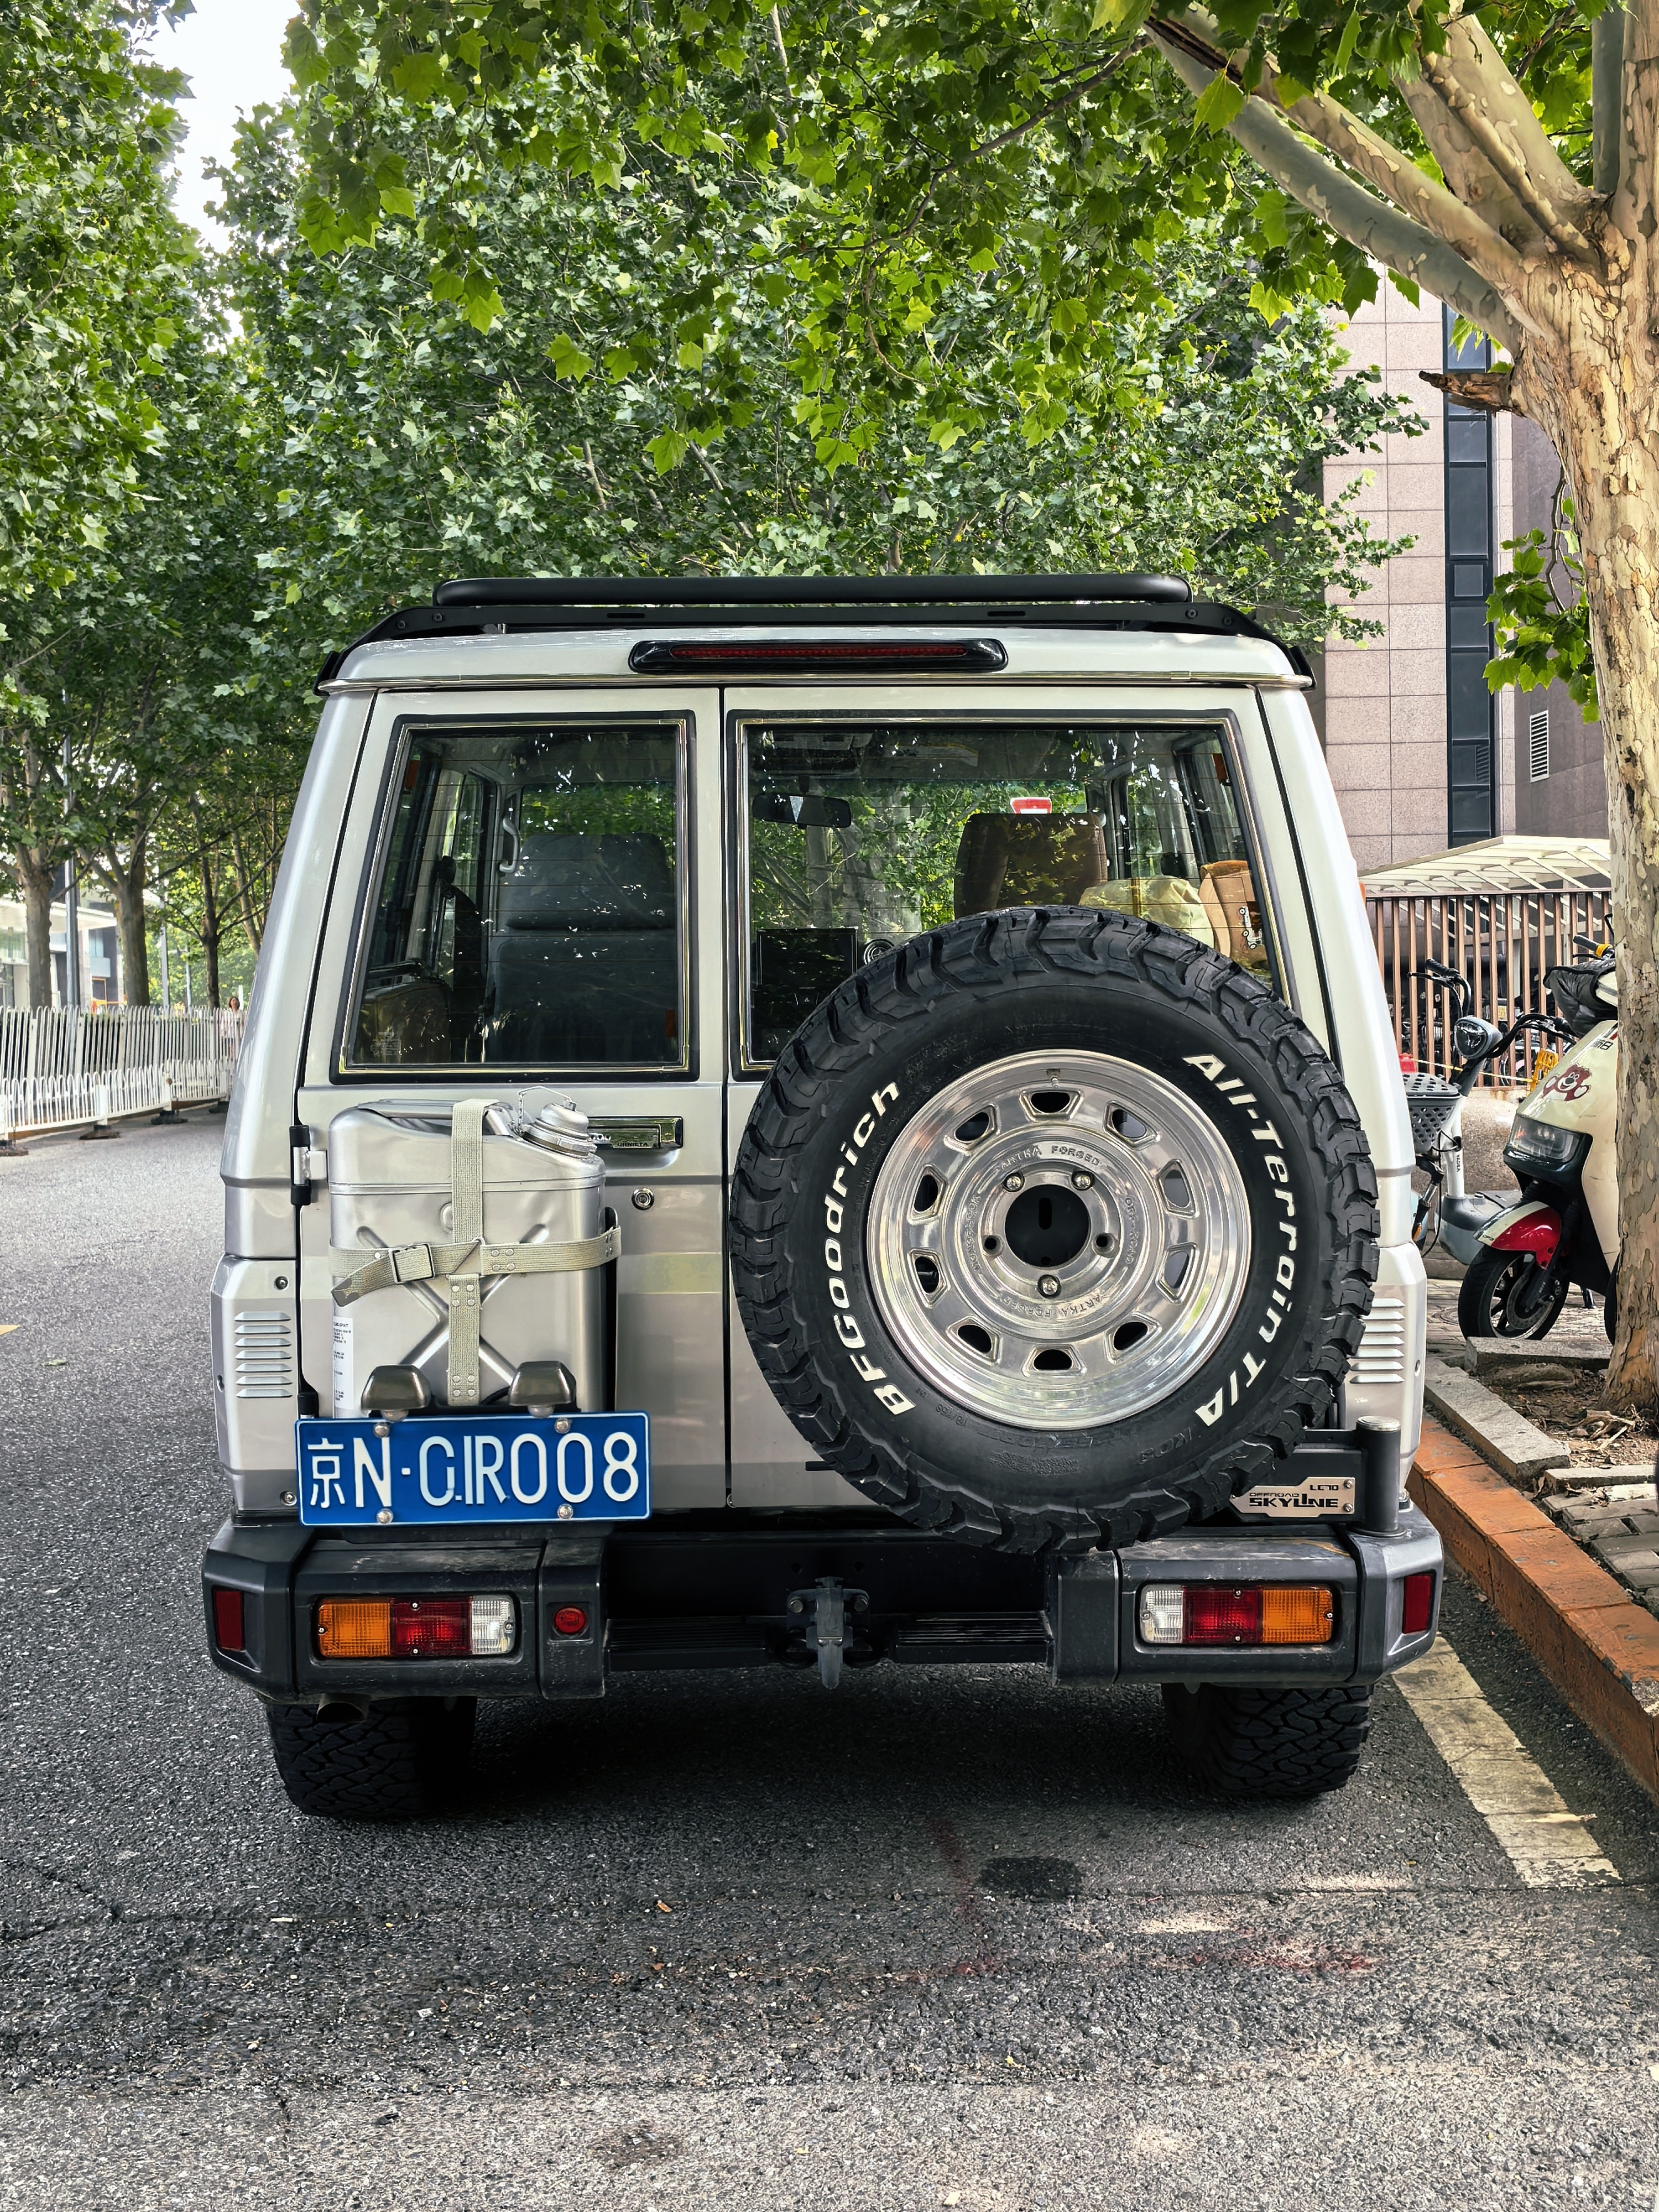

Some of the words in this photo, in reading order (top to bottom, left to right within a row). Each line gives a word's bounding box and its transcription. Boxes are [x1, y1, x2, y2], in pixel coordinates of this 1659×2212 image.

[1051, 1145, 1100, 1166] FORGED
[1183, 1053, 1297, 1343] All-Terrain
[823, 1082, 916, 1416] BFGoodrich
[1001, 1295, 1051, 1317] FORGED
[1060, 1293, 1102, 1316] ARTKA
[1194, 1352, 1266, 1427] T/A
[1249, 1494, 1338, 1507] SKYLINE
